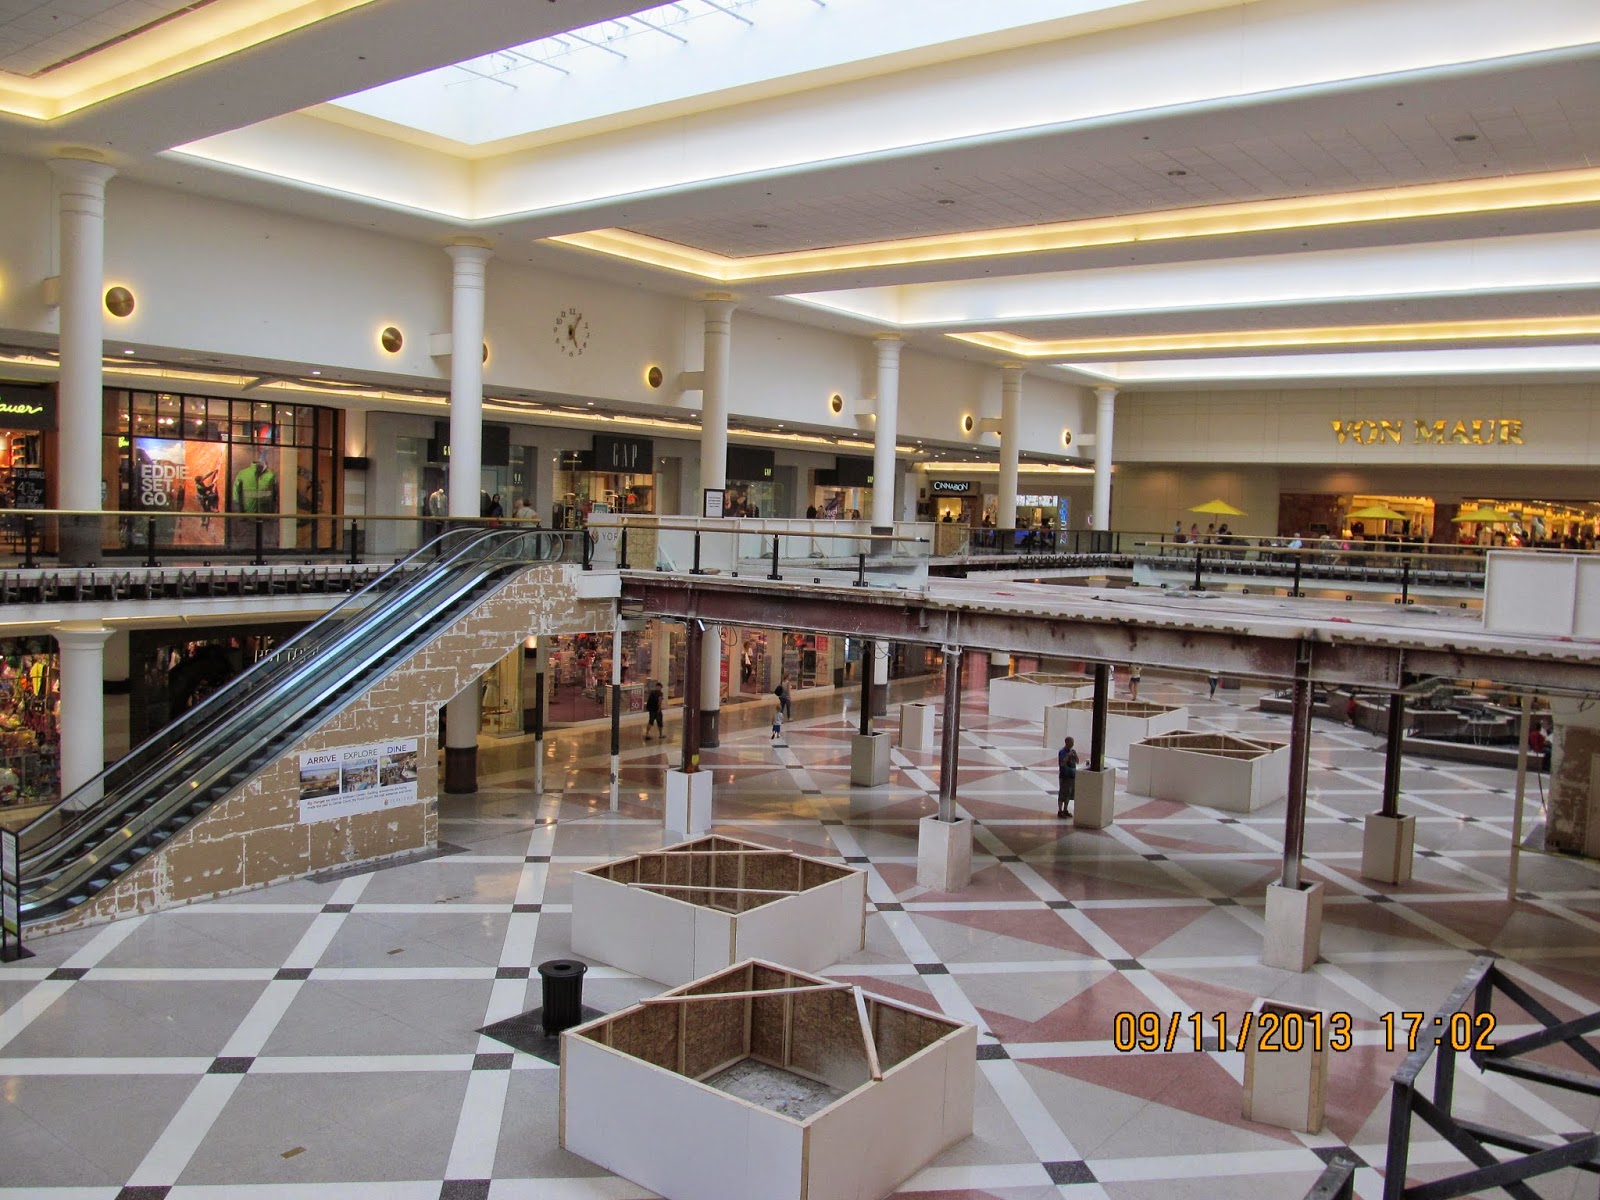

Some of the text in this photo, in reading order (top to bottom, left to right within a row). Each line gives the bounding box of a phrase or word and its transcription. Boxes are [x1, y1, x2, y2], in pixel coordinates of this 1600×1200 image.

[0, 402, 43, 414] auer
[1330, 420, 1525, 445] VON MAUR
[613, 443, 638, 468] GAP
[142, 464, 193, 480] EDDIE.
[142, 479, 175, 493] SET.
[934, 481, 969, 492] CINNABON
[141, 491, 170, 506] GO.
[307, 744, 407, 765] ARRIVE EXPLORE DINE
